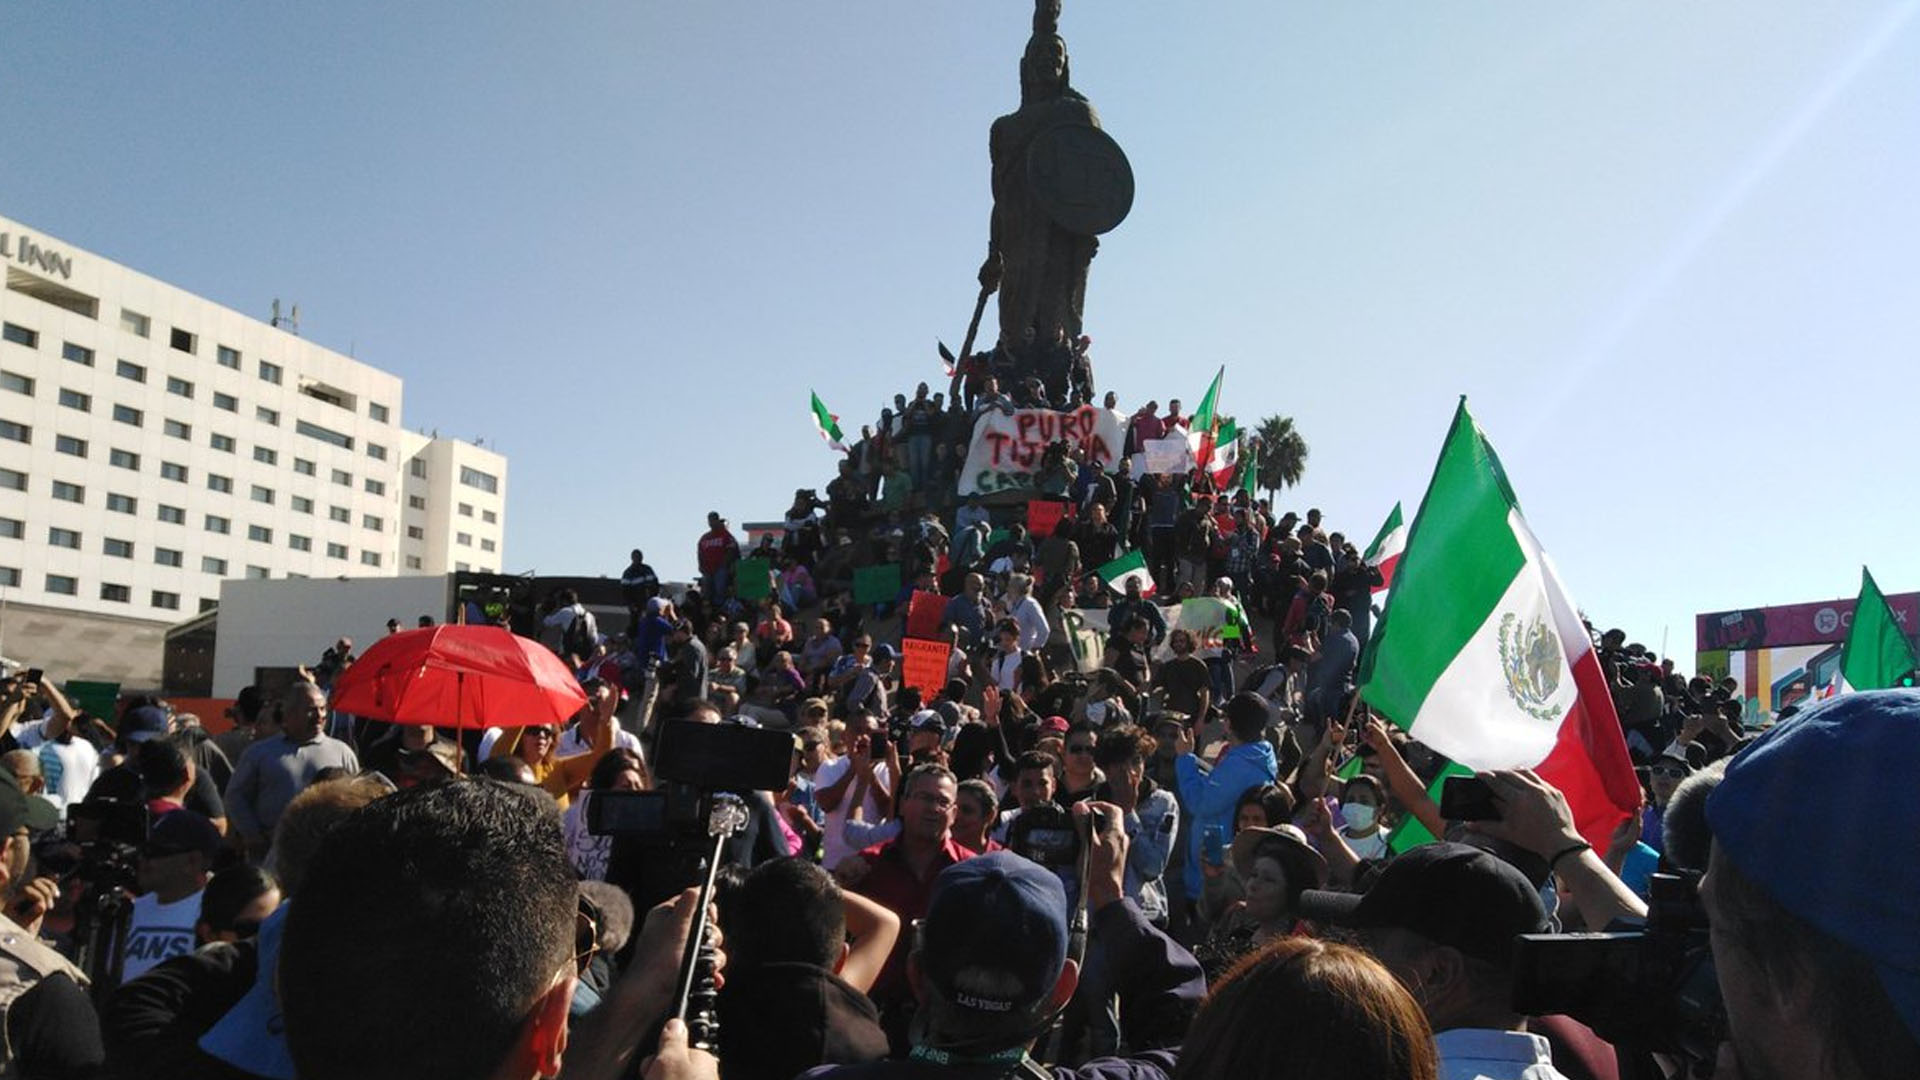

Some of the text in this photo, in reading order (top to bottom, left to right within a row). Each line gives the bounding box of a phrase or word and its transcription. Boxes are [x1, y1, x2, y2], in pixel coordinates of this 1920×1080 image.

[18, 235, 72, 279] INN
[1015, 404, 1099, 441] PURO
[957, 992, 1012, 1012] LAS VEGAS
